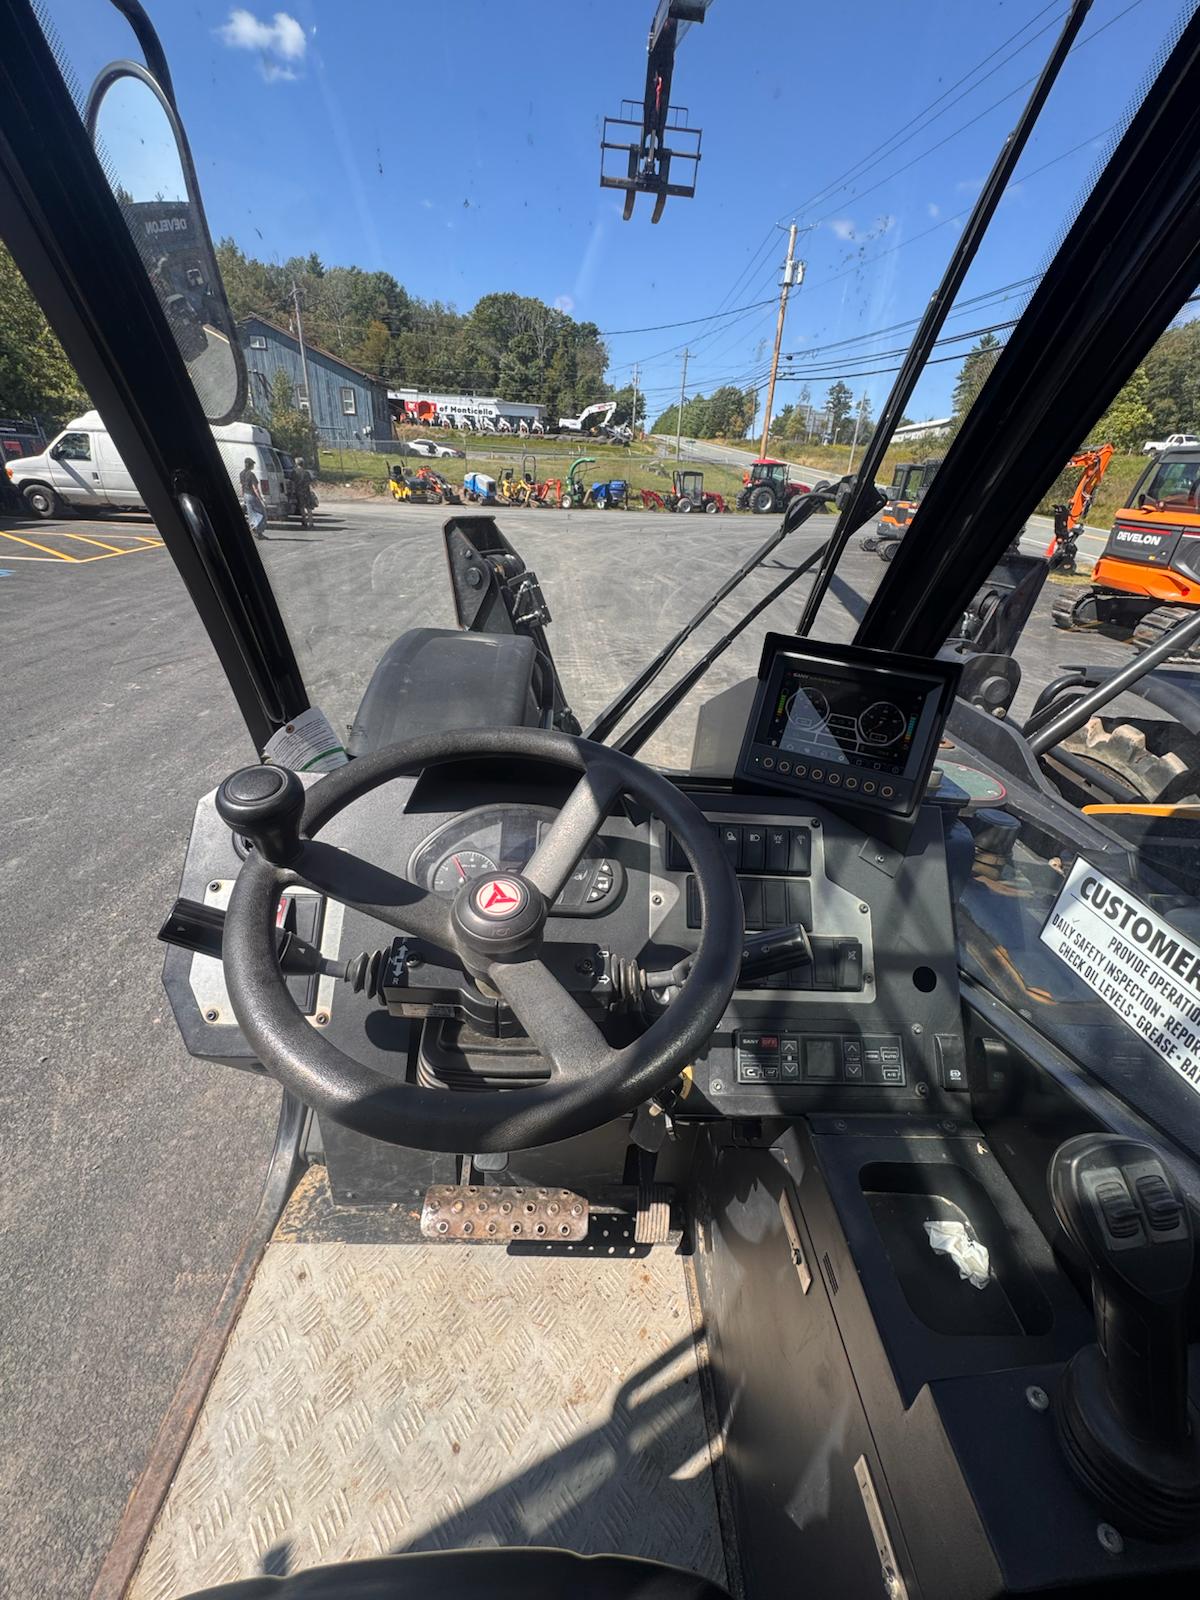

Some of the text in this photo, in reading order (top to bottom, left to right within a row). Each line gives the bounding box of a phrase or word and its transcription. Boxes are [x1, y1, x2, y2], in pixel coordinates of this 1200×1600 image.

[450, 406, 493, 416] Monticello
[1116, 531, 1162, 546] DEVELON
[392, 977, 400, 985] R
[1052, 913, 1076, 940] DAILY
[1073, 932, 1107, 967] SAFETY
[1103, 960, 1162, 1018] INSPECTION
[1163, 1014, 1200, 1060] REPOR
[1058, 941, 1087, 973] CHECK
[1083, 965, 1099, 987] OIL
[1098, 978, 1134, 1017] LEVELS
[1135, 1015, 1178, 1060] GREASE
[1107, 936, 1200, 1027] PROVIDE OPERATIO
